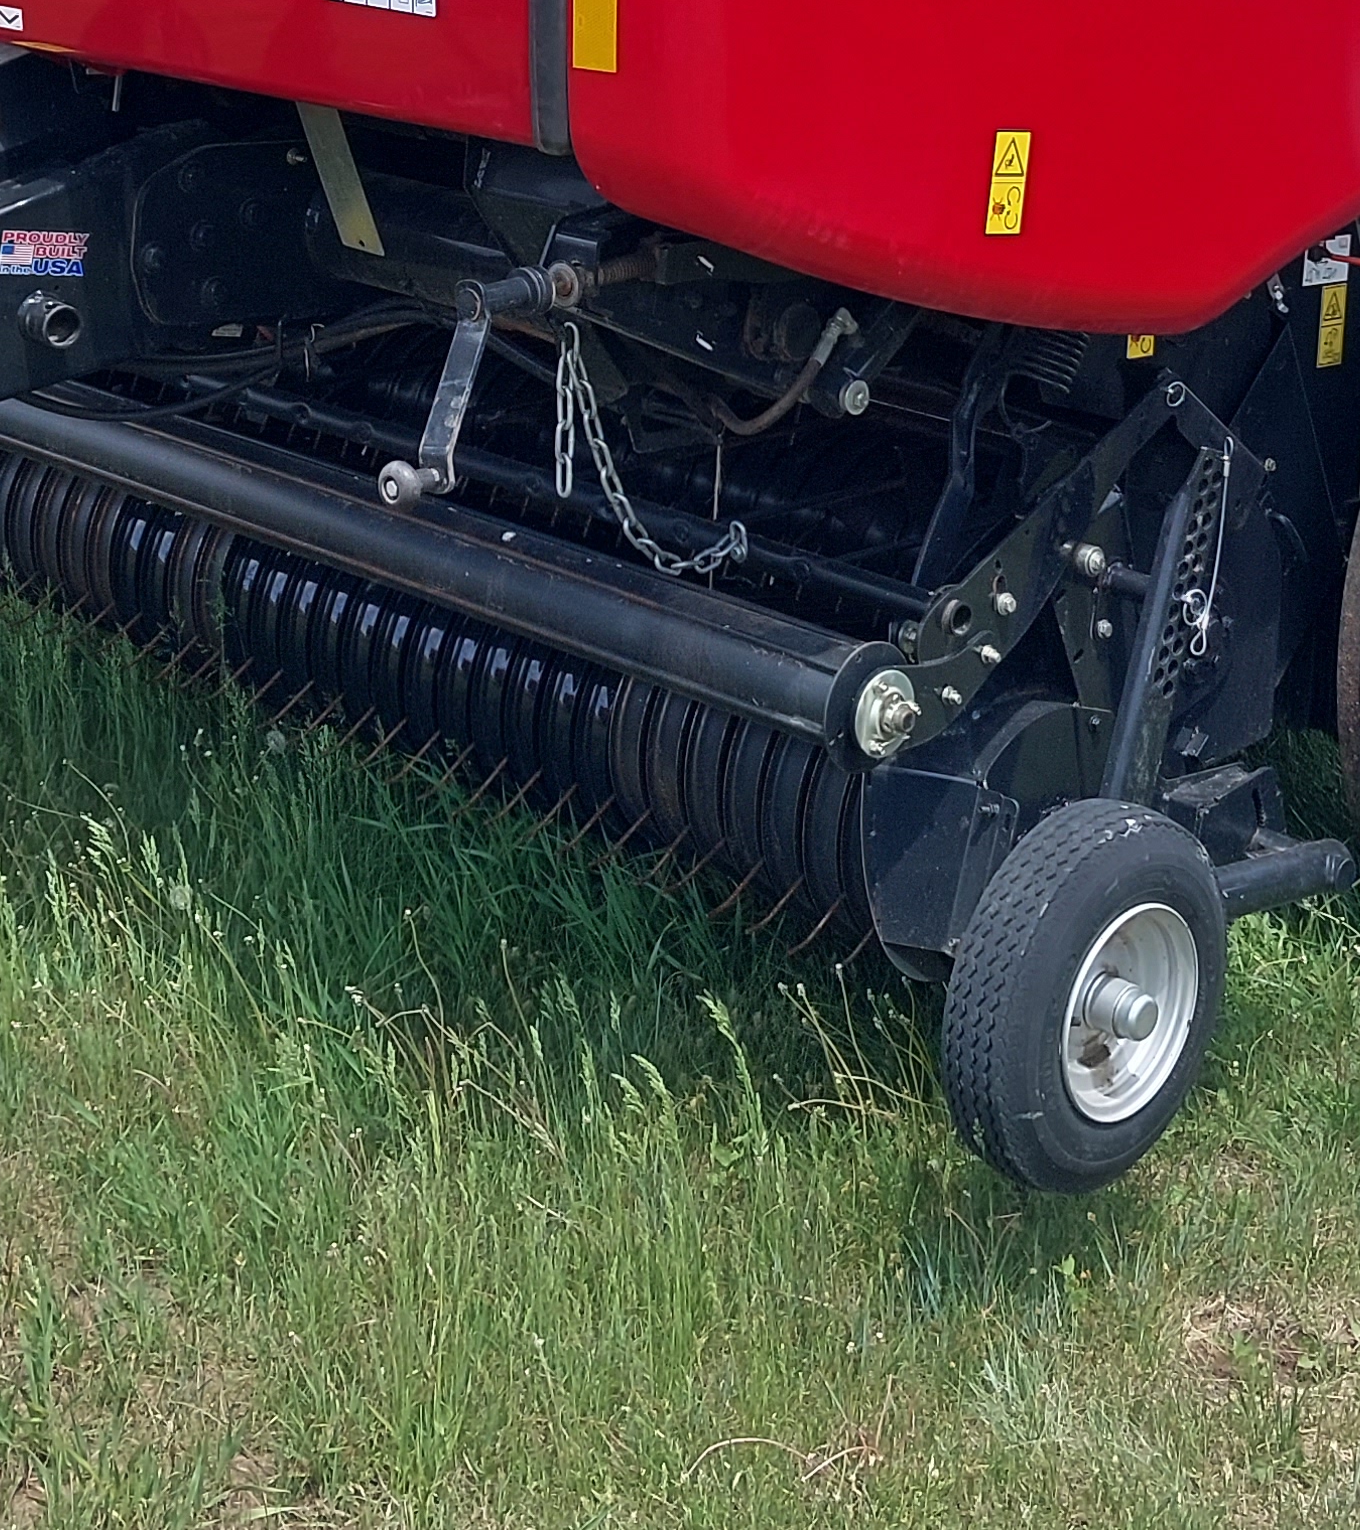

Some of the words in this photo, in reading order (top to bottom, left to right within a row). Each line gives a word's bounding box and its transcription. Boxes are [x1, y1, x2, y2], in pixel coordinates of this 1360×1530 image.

[1, 230, 90, 246] PROUDLY
[34, 245, 88, 260] BUILT
[32, 258, 84, 276] USA
